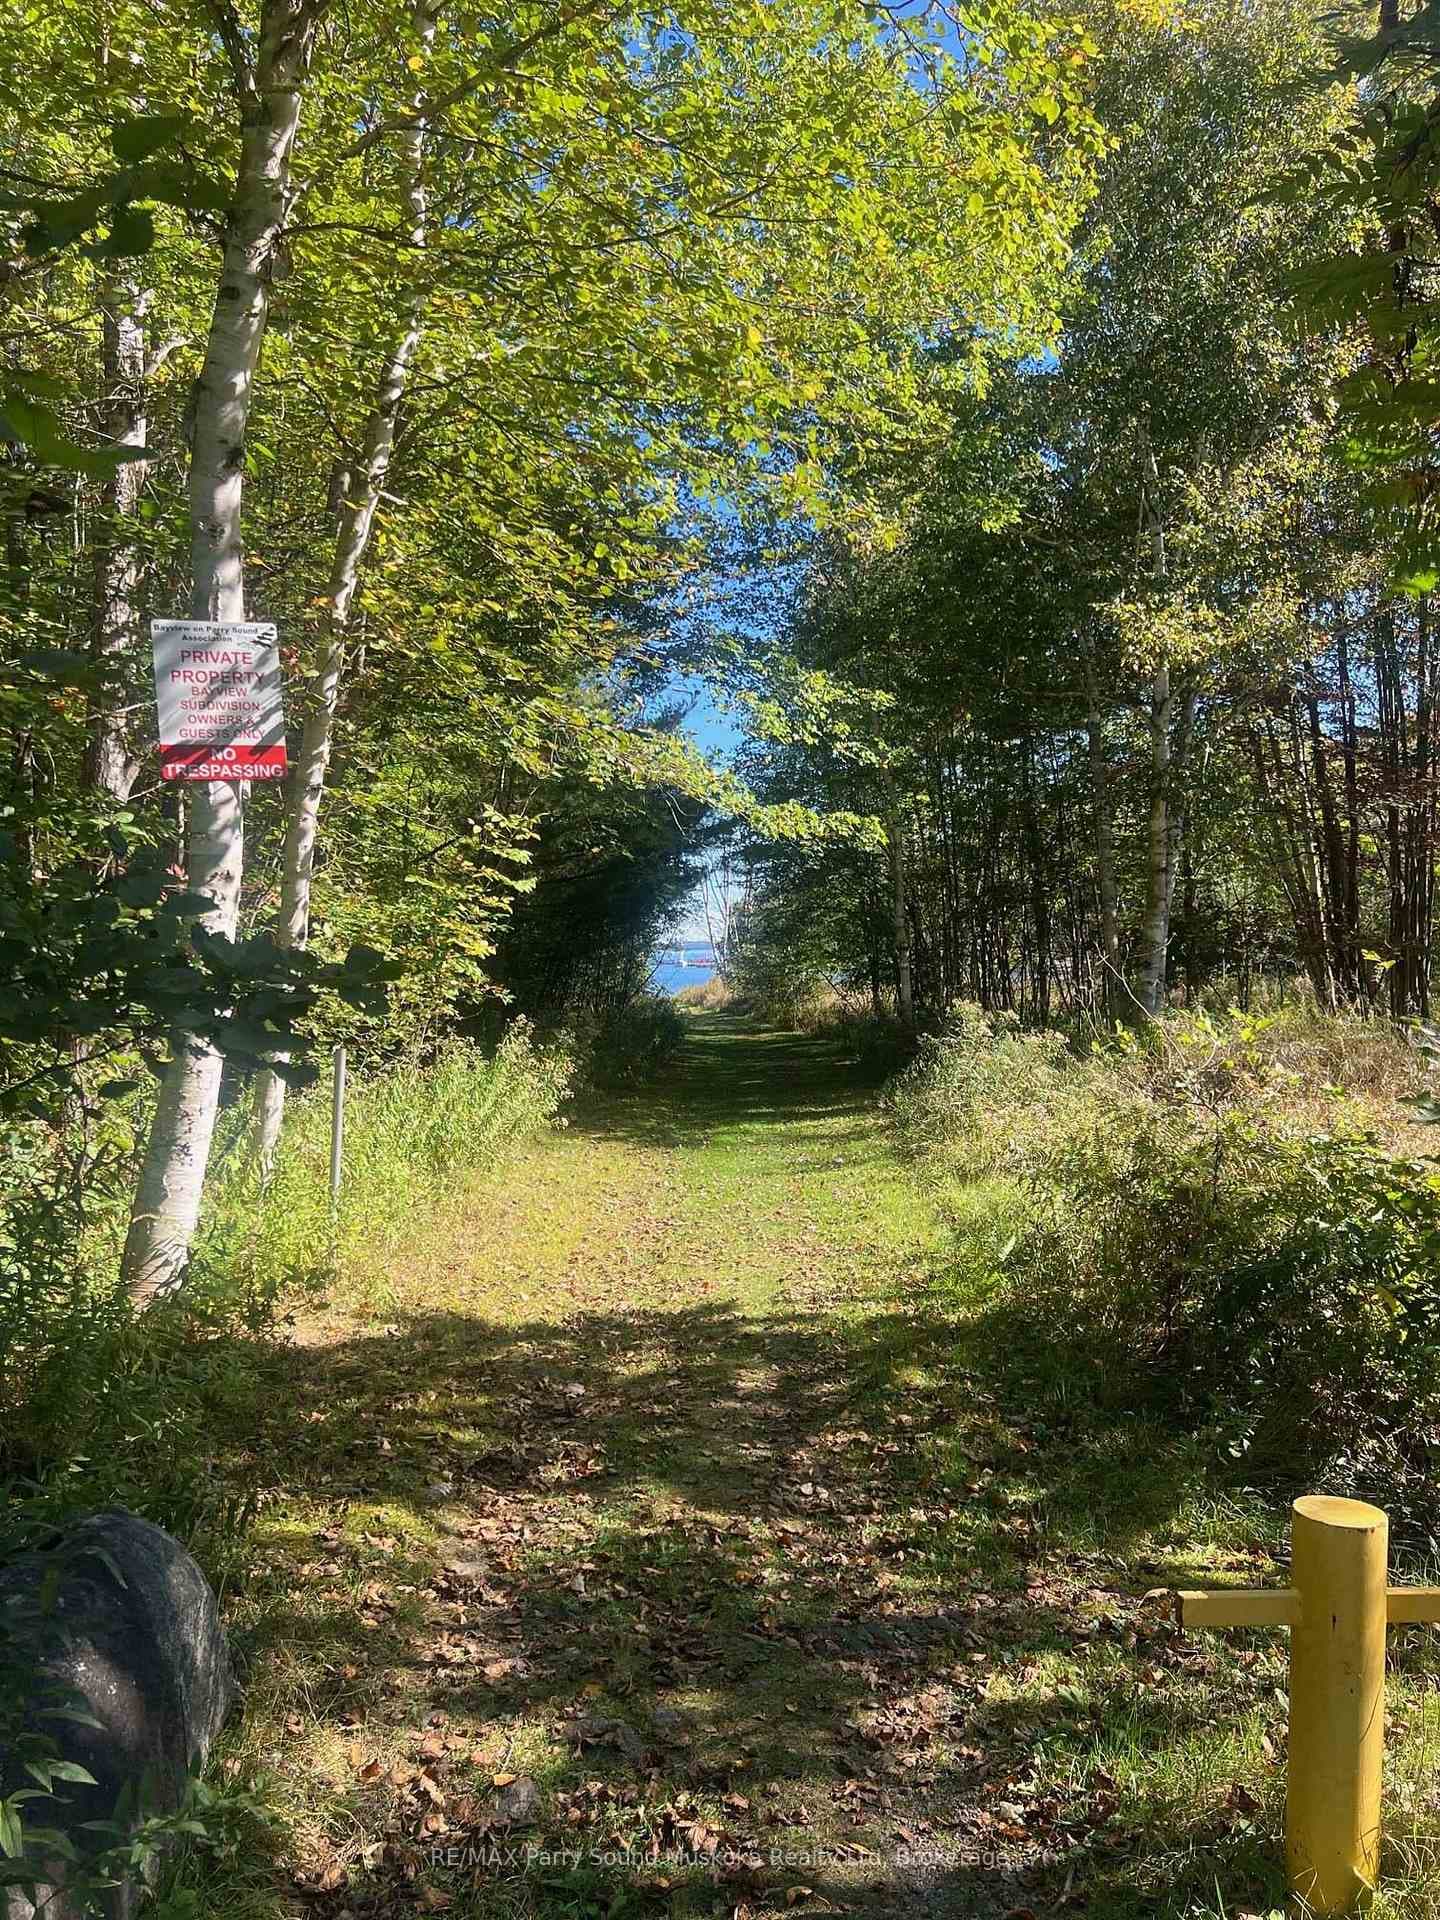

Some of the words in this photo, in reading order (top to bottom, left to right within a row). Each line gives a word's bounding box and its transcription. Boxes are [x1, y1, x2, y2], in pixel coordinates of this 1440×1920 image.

[232, 626, 258, 634] Sound
[181, 633, 232, 641] Association
[180, 650, 252, 665] PRIVATE
[170, 670, 265, 685] PROPERTY
[191, 686, 248, 697] BAYVIEW
[180, 700, 261, 711] SUBDIVISION
[187, 714, 242, 725] OWNERS
[246, 716, 254, 725] &
[179, 728, 231, 739] GUESTS
[233, 729, 265, 739] ONLY
[211, 748, 236, 761] NO
[165, 764, 284, 778] TRESPASSING
